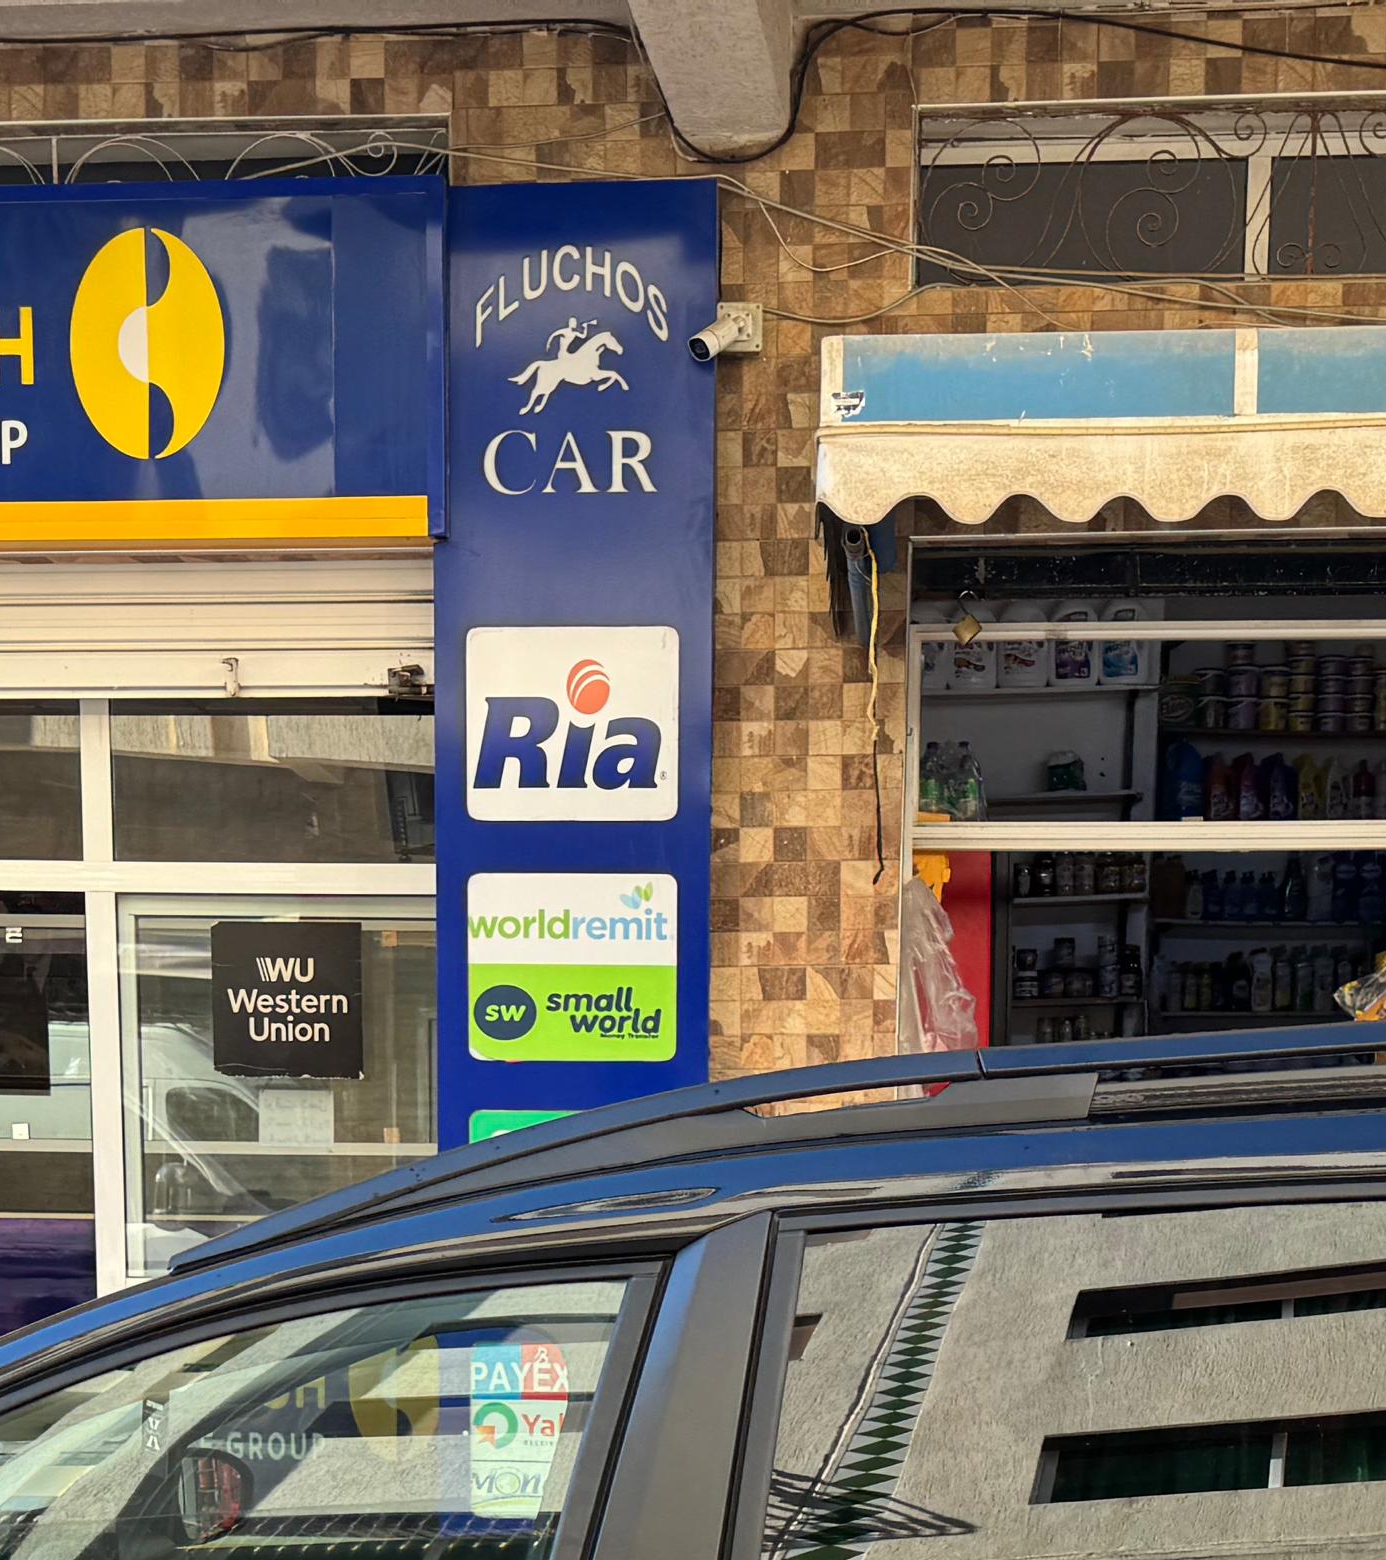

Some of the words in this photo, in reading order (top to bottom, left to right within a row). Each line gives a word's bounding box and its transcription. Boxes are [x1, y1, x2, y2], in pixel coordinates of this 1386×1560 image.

[475, 244, 669, 349] FLUCHOS
[483, 429, 658, 495] CAR
[473, 660, 662, 790] Ria
[468, 908, 668, 941] worldremit
[256, 957, 315, 982] WU
[227, 988, 349, 1014] Western
[545, 986, 633, 1012] small
[248, 1014, 331, 1042] Union
[569, 1007, 662, 1034] world
